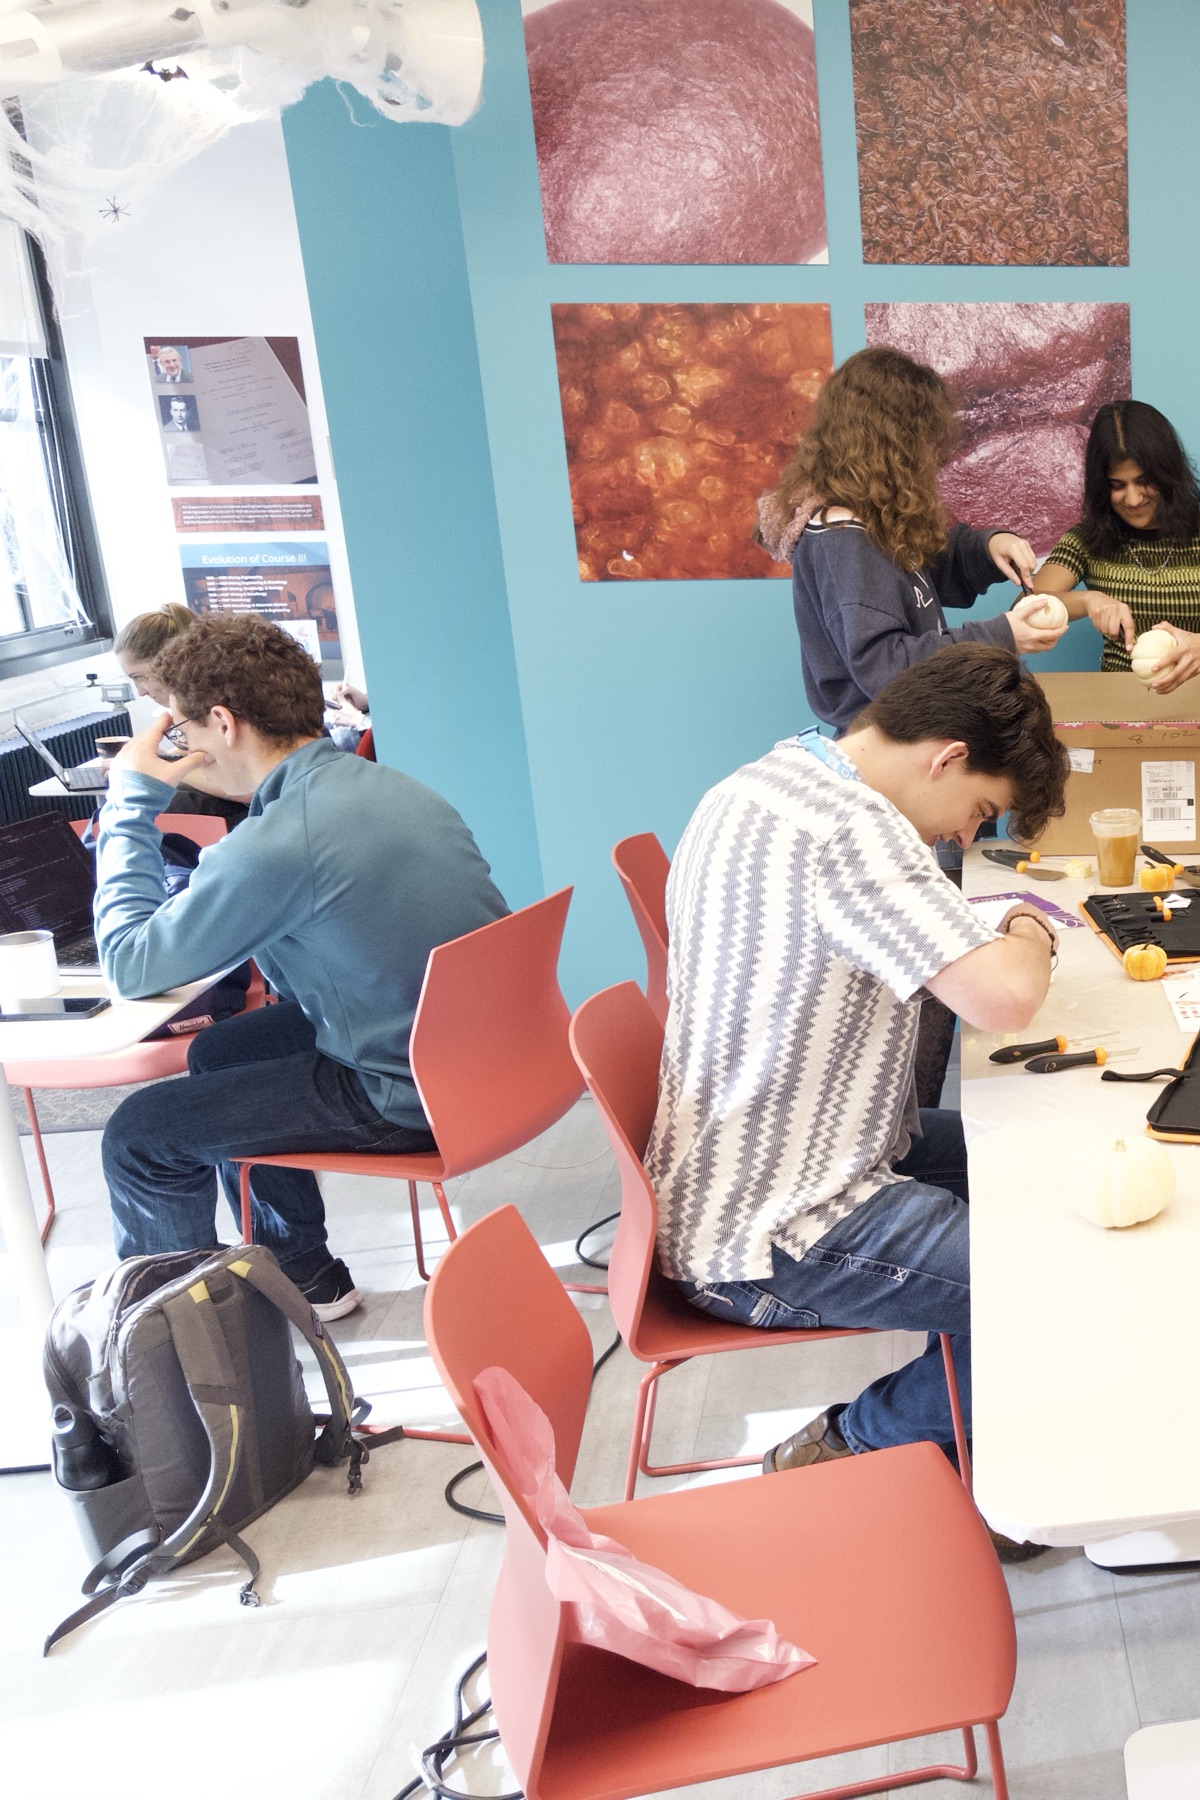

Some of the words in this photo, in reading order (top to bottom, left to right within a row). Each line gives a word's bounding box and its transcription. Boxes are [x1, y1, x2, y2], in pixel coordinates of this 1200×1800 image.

[202, 554, 247, 564] Evolution
[250, 553, 260, 563] of
[261, 553, 296, 563] Course
[298, 553, 307, 562] III
